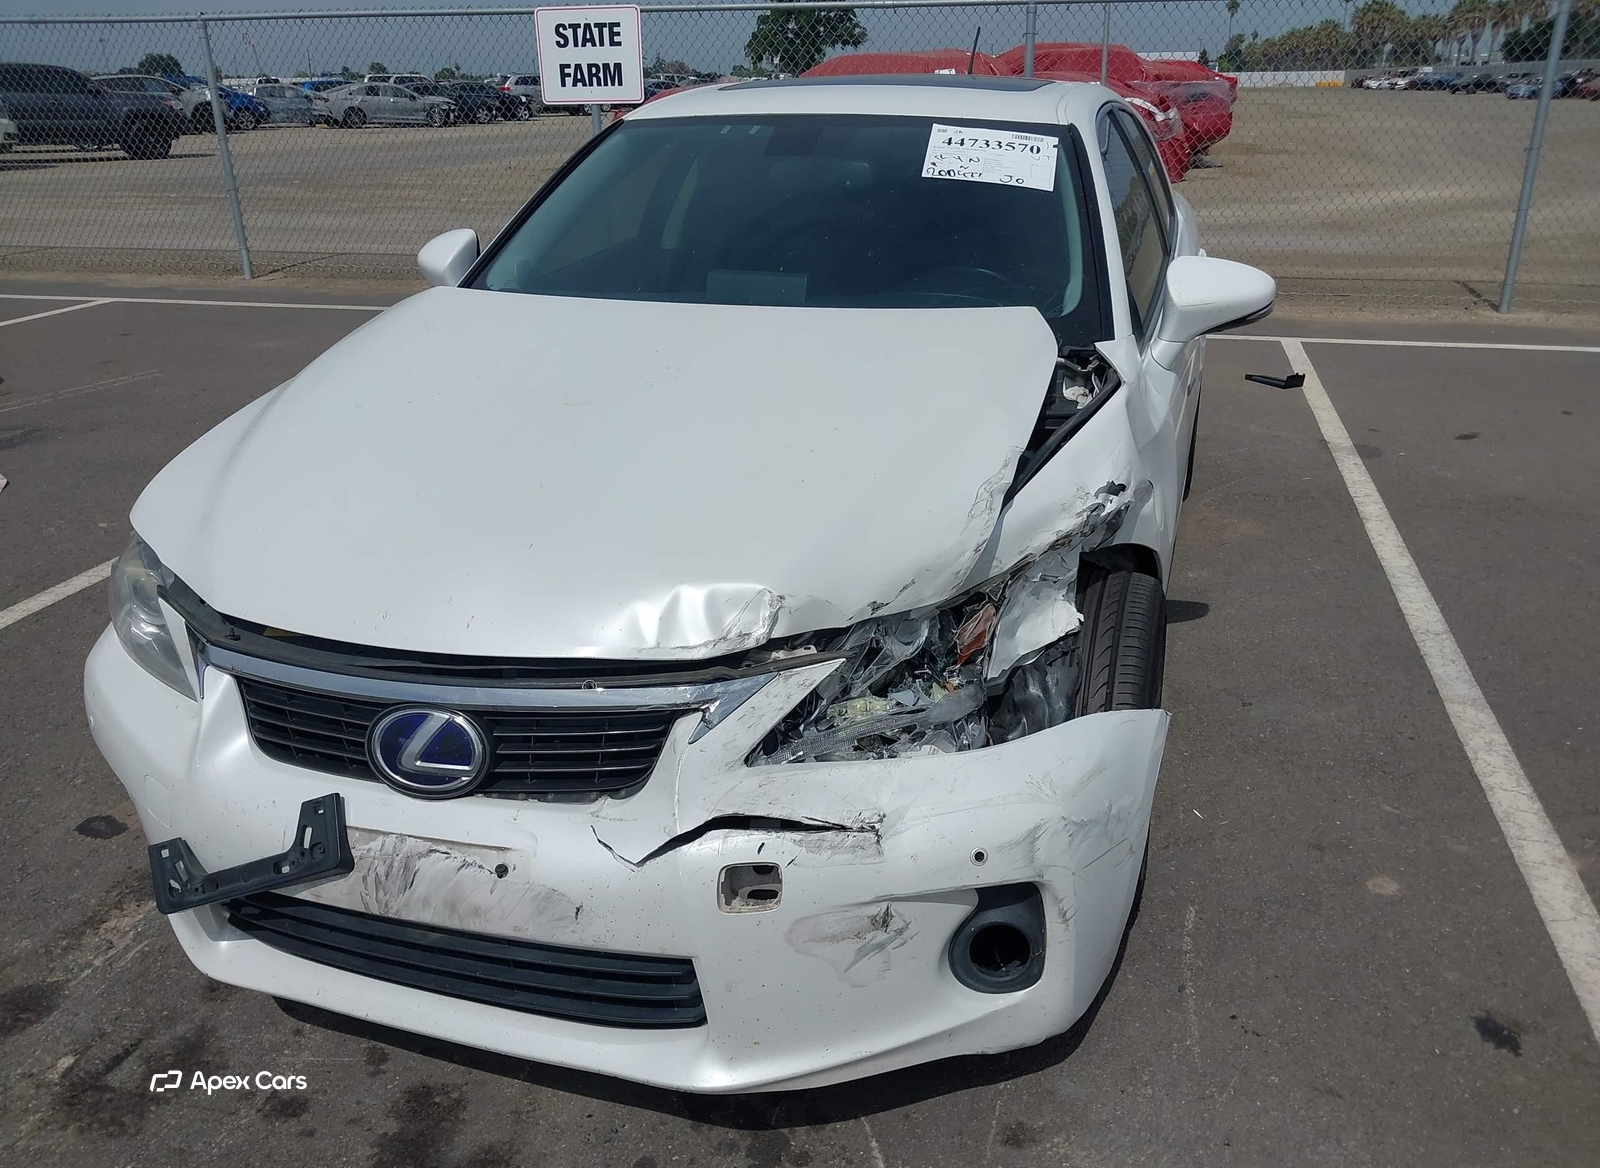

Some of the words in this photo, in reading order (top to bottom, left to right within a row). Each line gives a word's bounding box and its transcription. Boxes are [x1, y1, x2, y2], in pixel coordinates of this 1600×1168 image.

[554, 22, 622, 48] STATE
[559, 62, 623, 87] FARM
[941, 136, 1041, 155] 44733570
